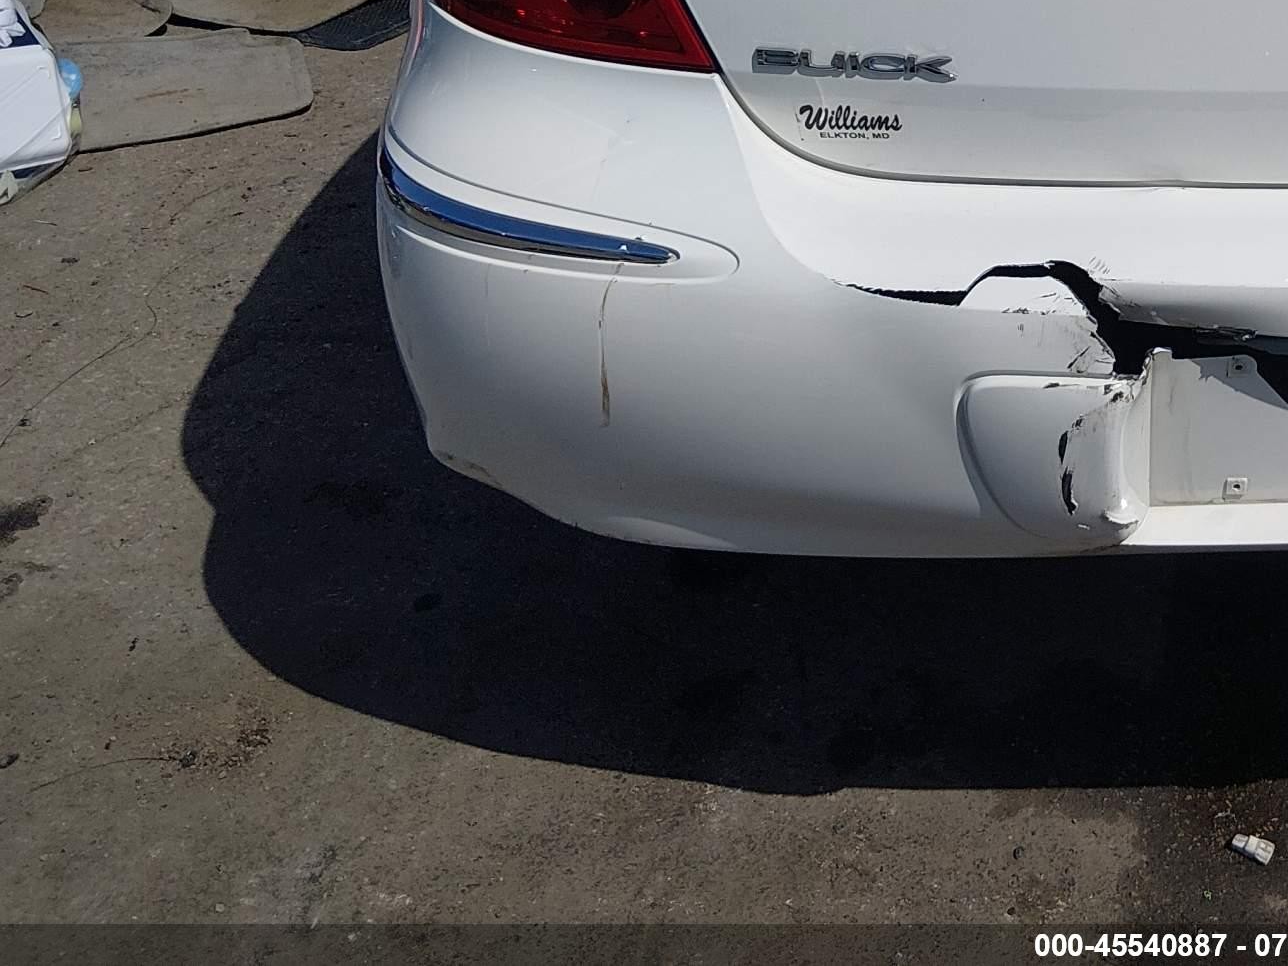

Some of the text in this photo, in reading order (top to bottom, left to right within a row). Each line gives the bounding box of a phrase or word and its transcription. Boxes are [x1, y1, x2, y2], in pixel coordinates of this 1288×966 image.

[752, 46, 958, 83] BUICK
[798, 104, 903, 132] Williams
[819, 131, 890, 140] ELKTON, MD
